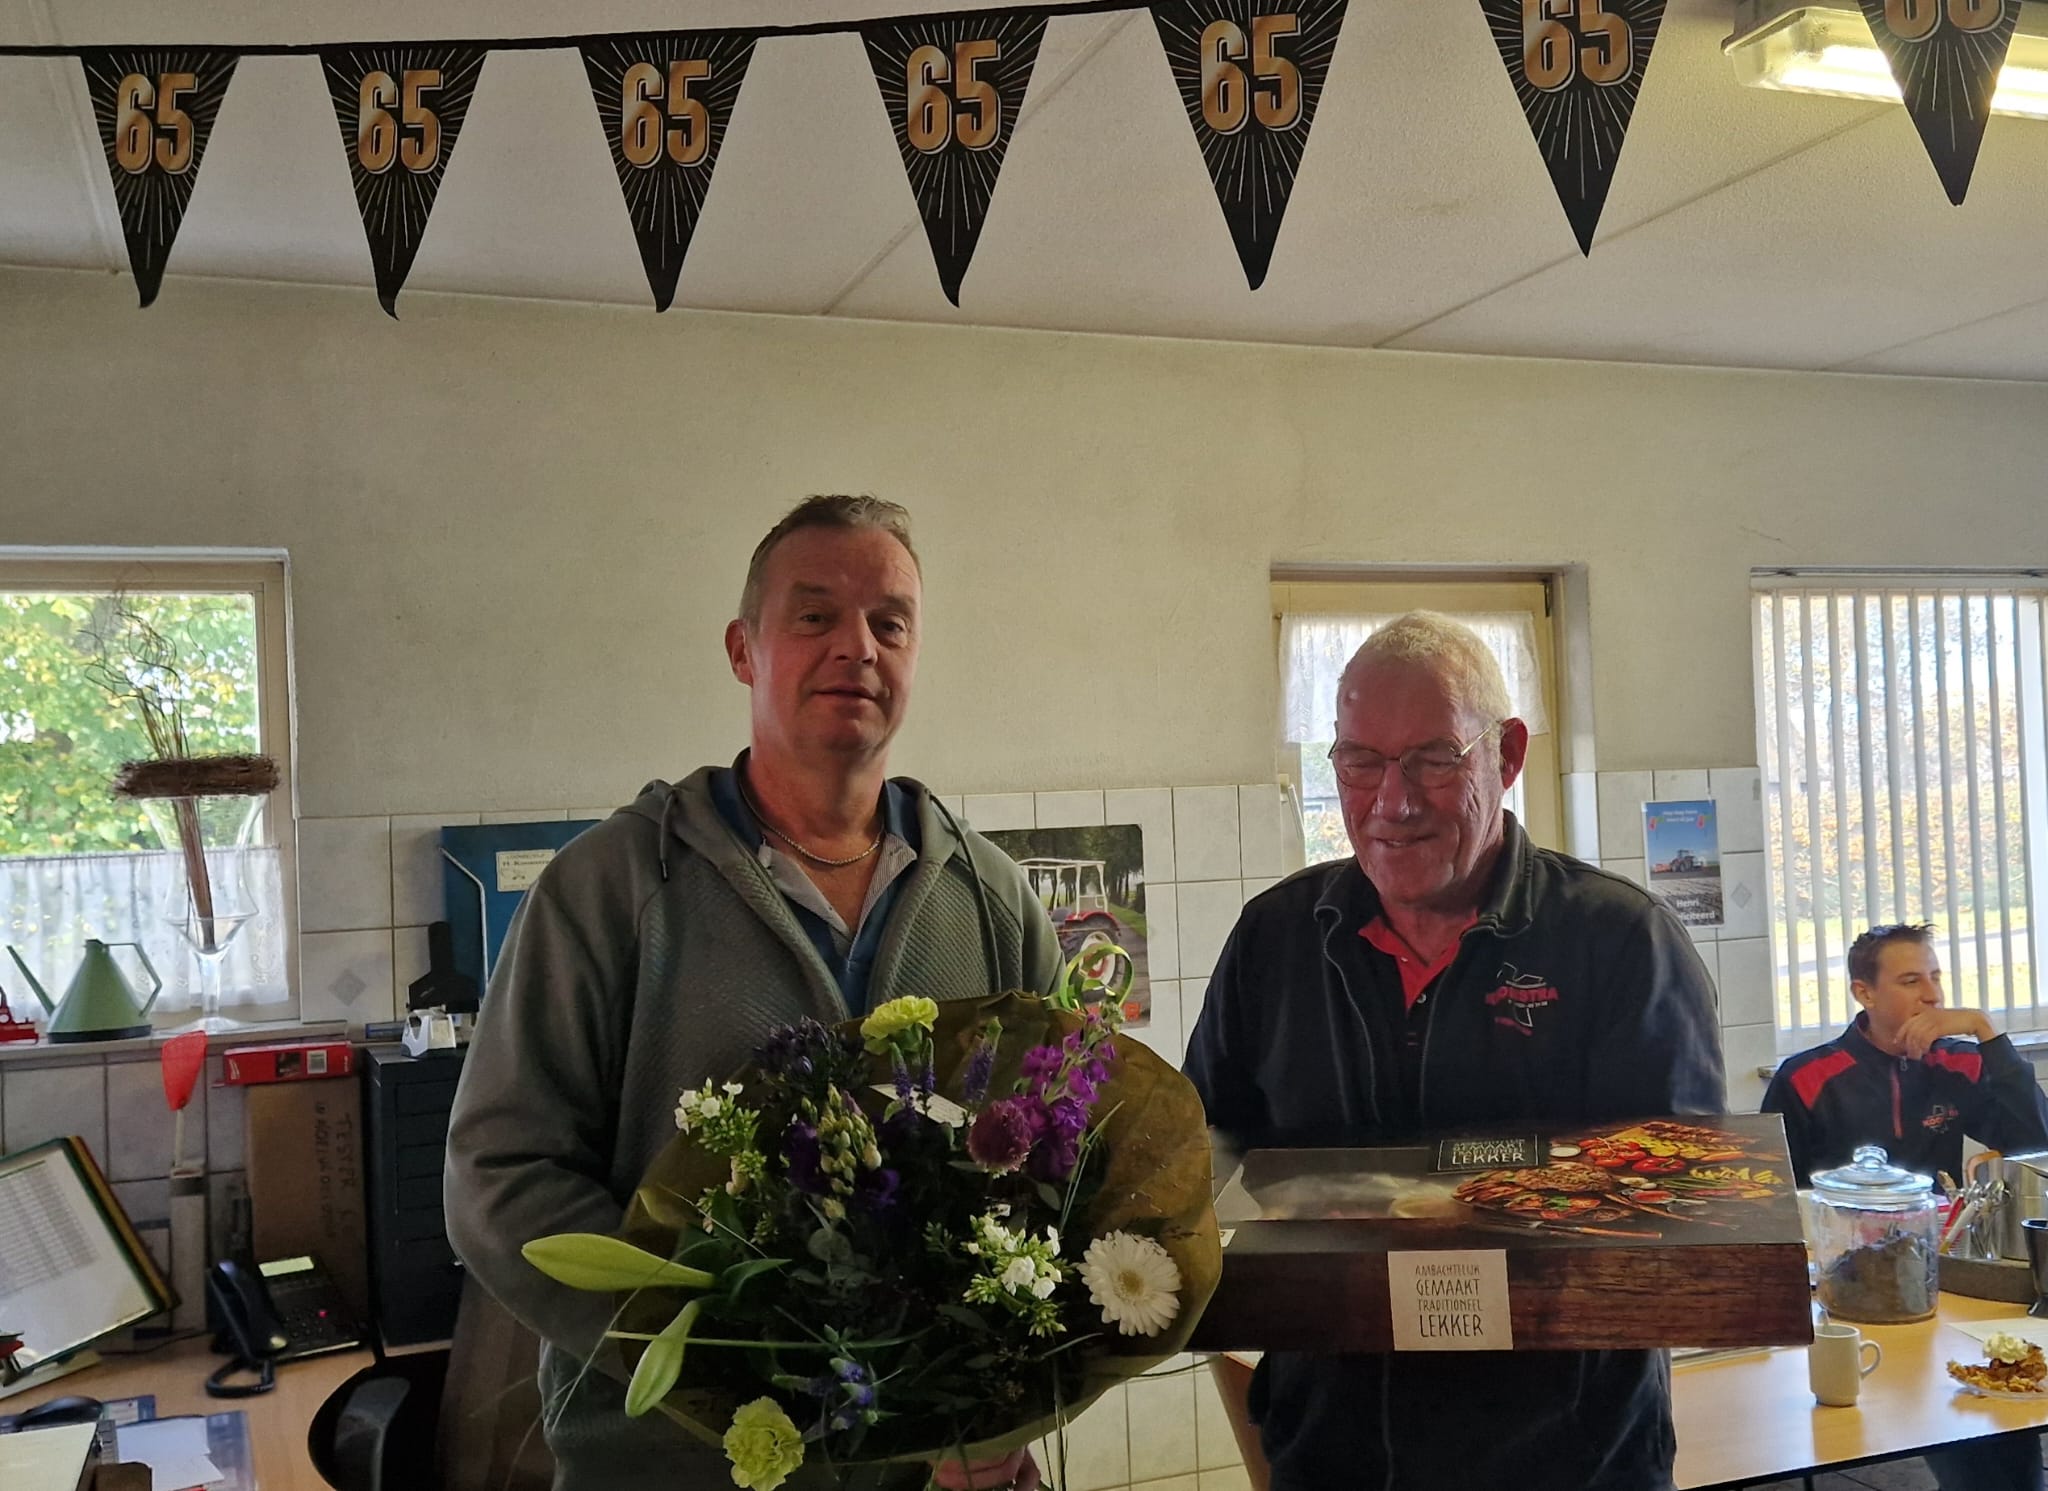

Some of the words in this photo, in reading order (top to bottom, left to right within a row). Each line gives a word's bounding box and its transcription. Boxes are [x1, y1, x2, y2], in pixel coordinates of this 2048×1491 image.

[1200, 13, 1301, 135] 65
[1522, 0, 1634, 92] 65
[115, 72, 198, 174] 65
[358, 69, 443, 174] 65
[622, 60, 711, 168] 65
[906, 39, 1000, 155] 65
[1678, 910, 1715, 920] liciteerd
[1452, 1151, 1525, 1165] LEKKER
[1416, 1278, 1481, 1296] GEMAAKT
[1418, 1299, 1484, 1312] TRADITIONEEL
[1419, 1313, 1484, 1338] LEKKER
